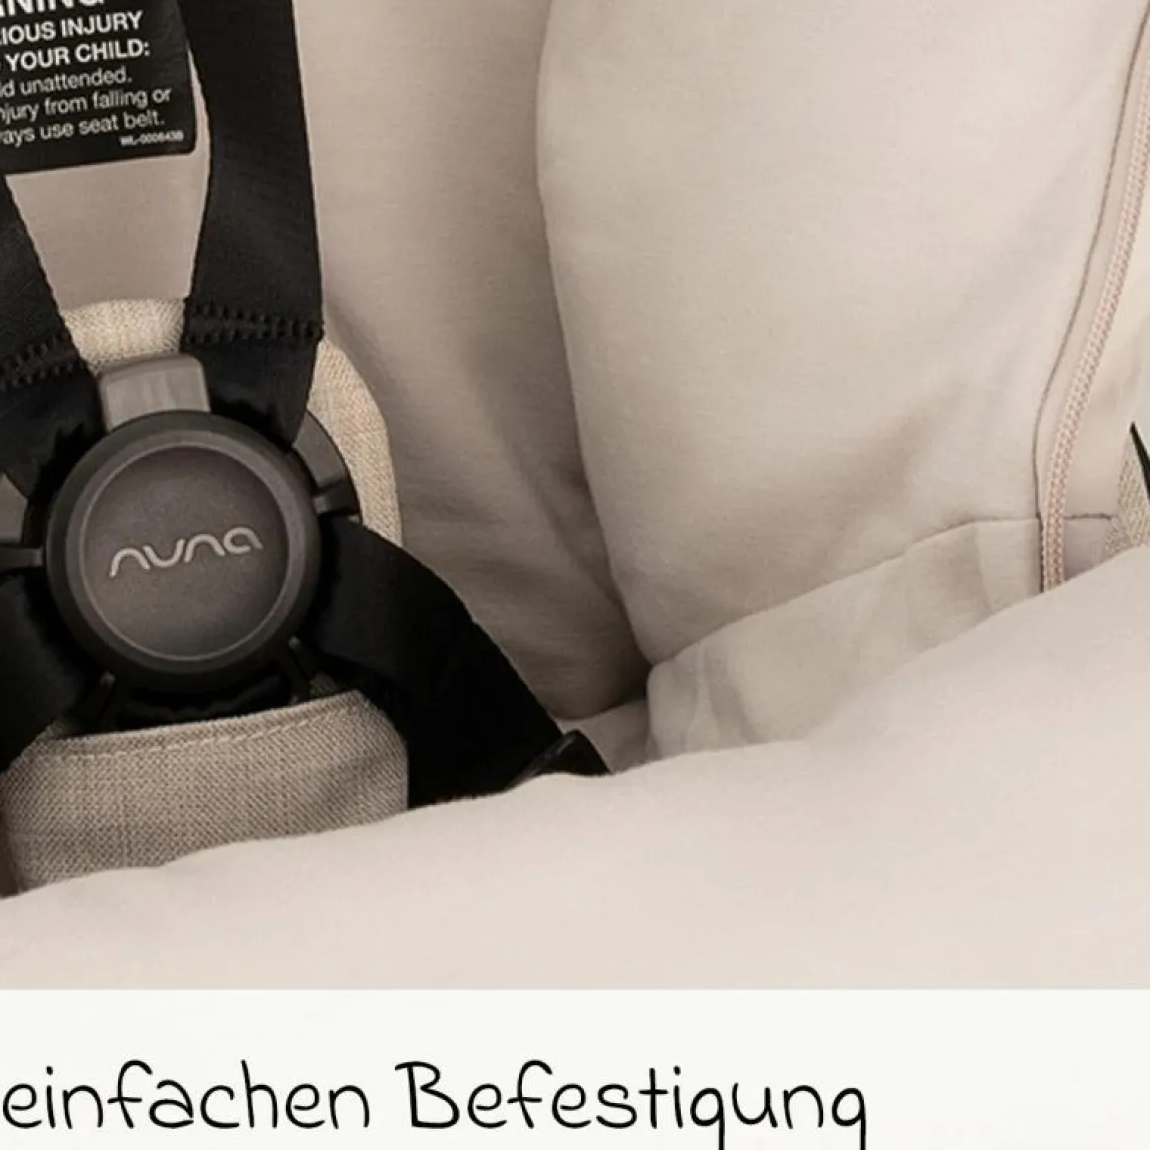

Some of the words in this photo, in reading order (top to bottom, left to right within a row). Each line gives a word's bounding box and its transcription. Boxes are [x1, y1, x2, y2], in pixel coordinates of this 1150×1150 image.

[61, 9, 144, 38] INJURY
[5, 46, 71, 73] YOUR
[74, 37, 151, 63] CHILD:
[20, 65, 133, 96] unattended.
[44, 96, 89, 116] from
[92, 89, 149, 110] falling
[152, 88, 172, 104] or
[40, 122, 74, 140] use
[78, 114, 119, 136] seat
[123, 108, 166, 129] belt.
[108, 526, 264, 578] nuna
